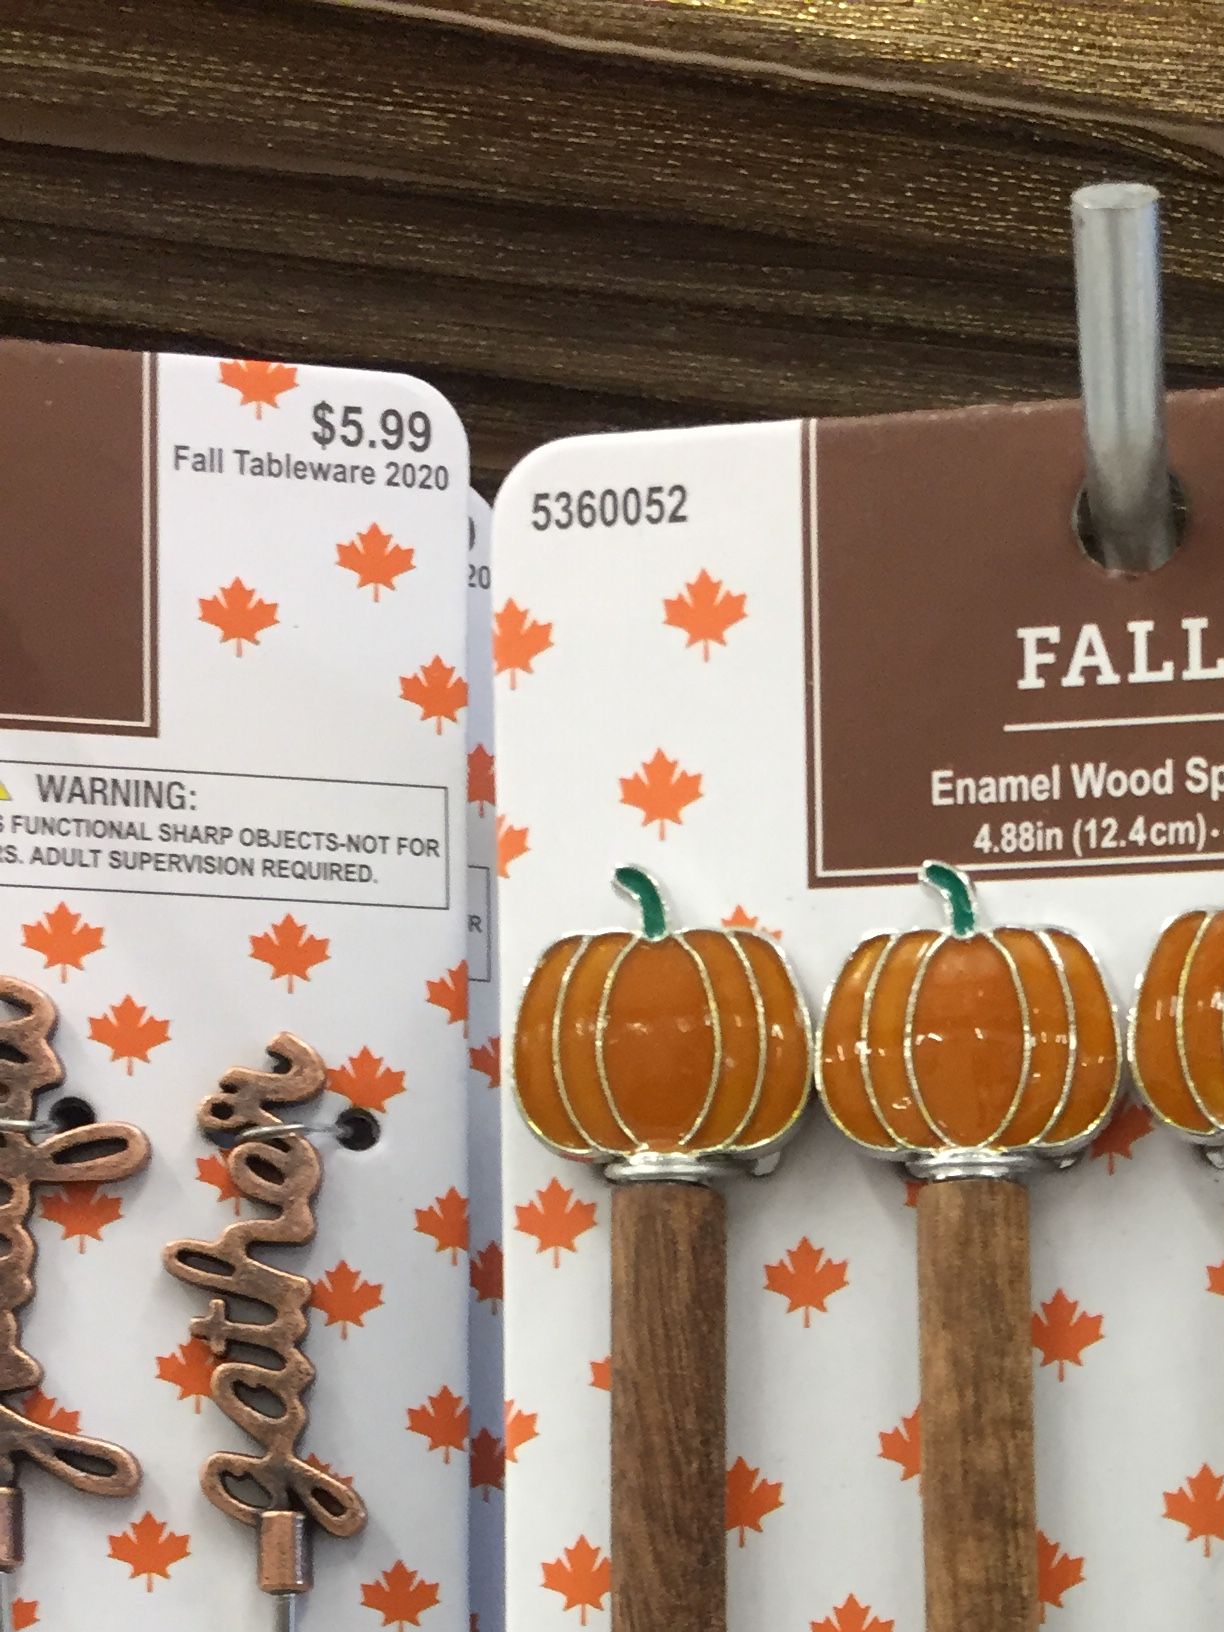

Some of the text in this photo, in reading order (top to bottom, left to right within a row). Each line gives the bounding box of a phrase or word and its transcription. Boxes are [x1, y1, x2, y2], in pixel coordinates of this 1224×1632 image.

[312, 401, 431, 453] $5.99
[173, 446, 449, 491] Fall Tableware 2020
[532, 484, 689, 530] 5360052
[36, 774, 197, 811] WARNING:
[931, 764, 1060, 806] Enamel
[1071, 758, 1174, 799] Wood
[11, 815, 152, 841] FUNCTIONAL
[158, 823, 233, 845] SHARP
[239, 827, 390, 854] OBJECTS-NOT
[397, 837, 440, 858] FOR
[974, 821, 1063, 854] 4.88in
[30, 846, 102, 868] ADULT
[109, 850, 255, 876] SUPERVISION
[262, 857, 378, 883] REQUIRED.
